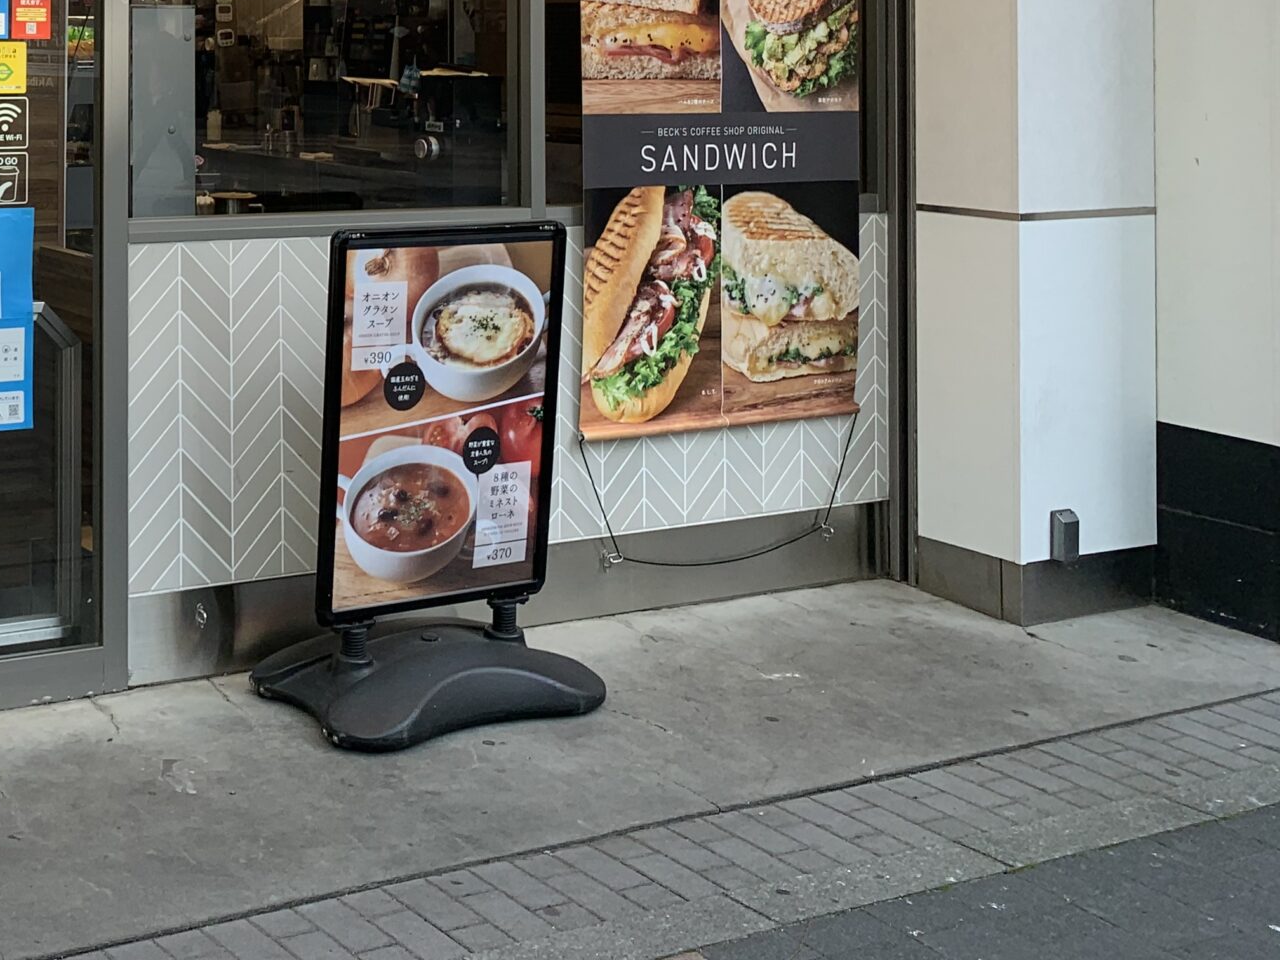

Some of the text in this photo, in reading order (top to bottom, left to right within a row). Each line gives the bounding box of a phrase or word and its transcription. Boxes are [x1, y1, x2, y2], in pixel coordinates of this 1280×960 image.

[5, 133, 23, 141] Wi-Fi
[657, 125, 785, 138] BECK'S COFFEE SHOP ORIGINAL
[4, 156, 18, 165] GO
[640, 142, 797, 173] SANDWICH
[362, 291, 400, 301] オニオン
[363, 304, 399, 315] グラタン
[367, 317, 394, 329] スープ
[364, 351, 392, 365] ¥390
[492, 471, 518, 483] 8種の
[490, 484, 517, 496] 野菜の
[488, 497, 519, 509] ミネスト
[491, 511, 515, 521] ローネ
[487, 547, 513, 561] ¥370
